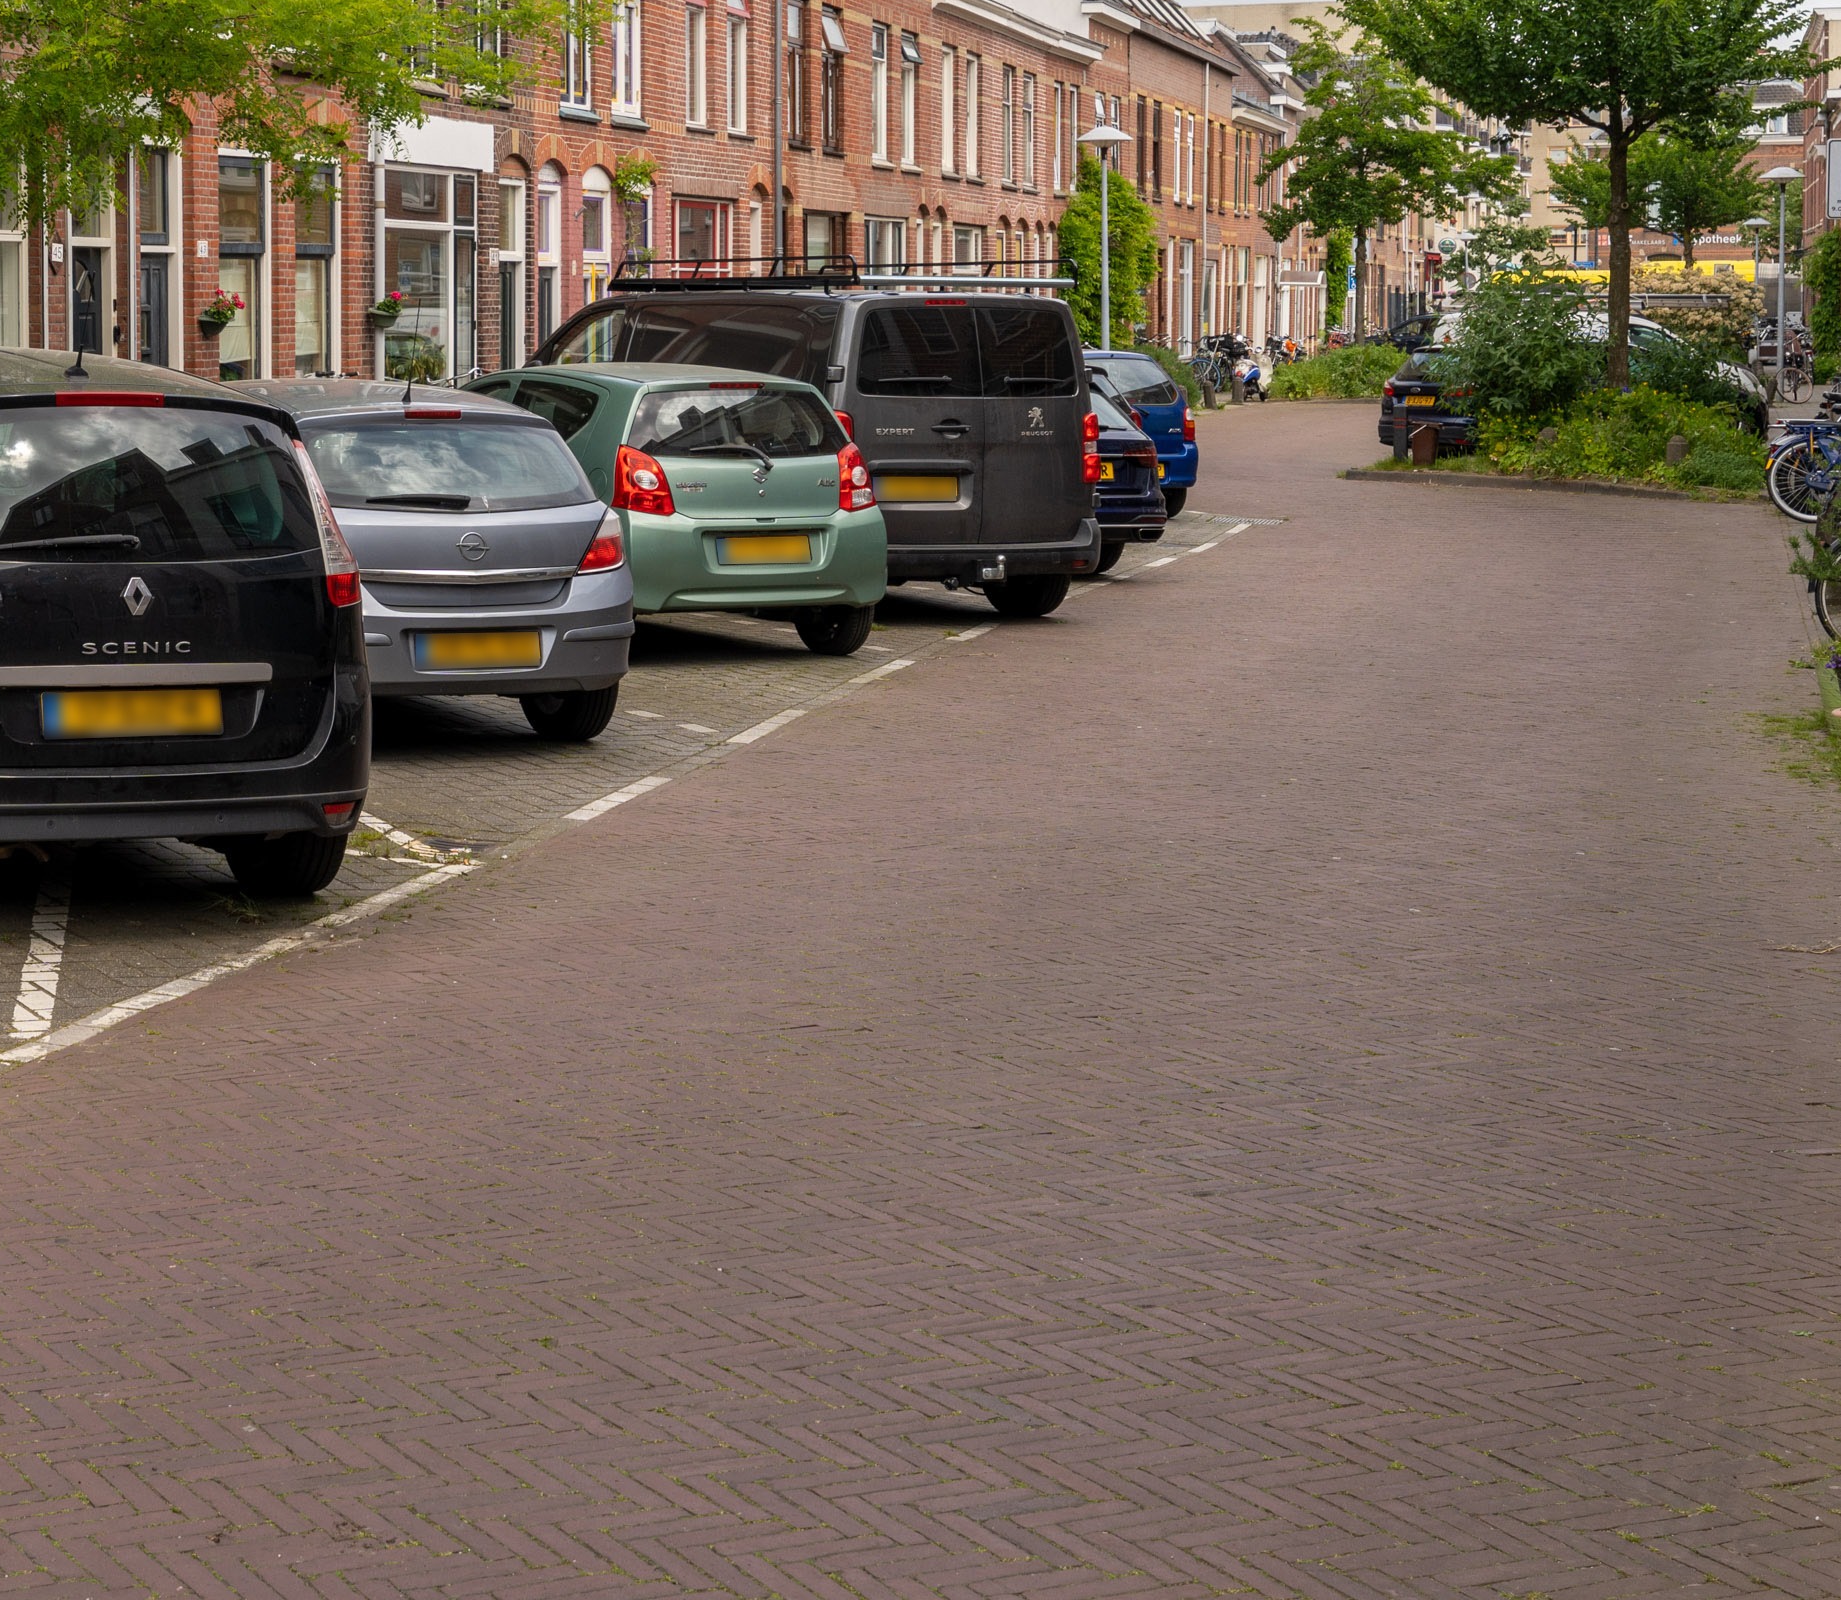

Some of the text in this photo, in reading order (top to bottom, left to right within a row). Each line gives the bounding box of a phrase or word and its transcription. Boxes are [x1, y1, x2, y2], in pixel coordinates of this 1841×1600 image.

[1692, 234, 1743, 247] ypotheek
[53, 246, 62, 260] 45
[875, 428, 915, 436] EXPERT
[81, 640, 191, 655] SCENIC
